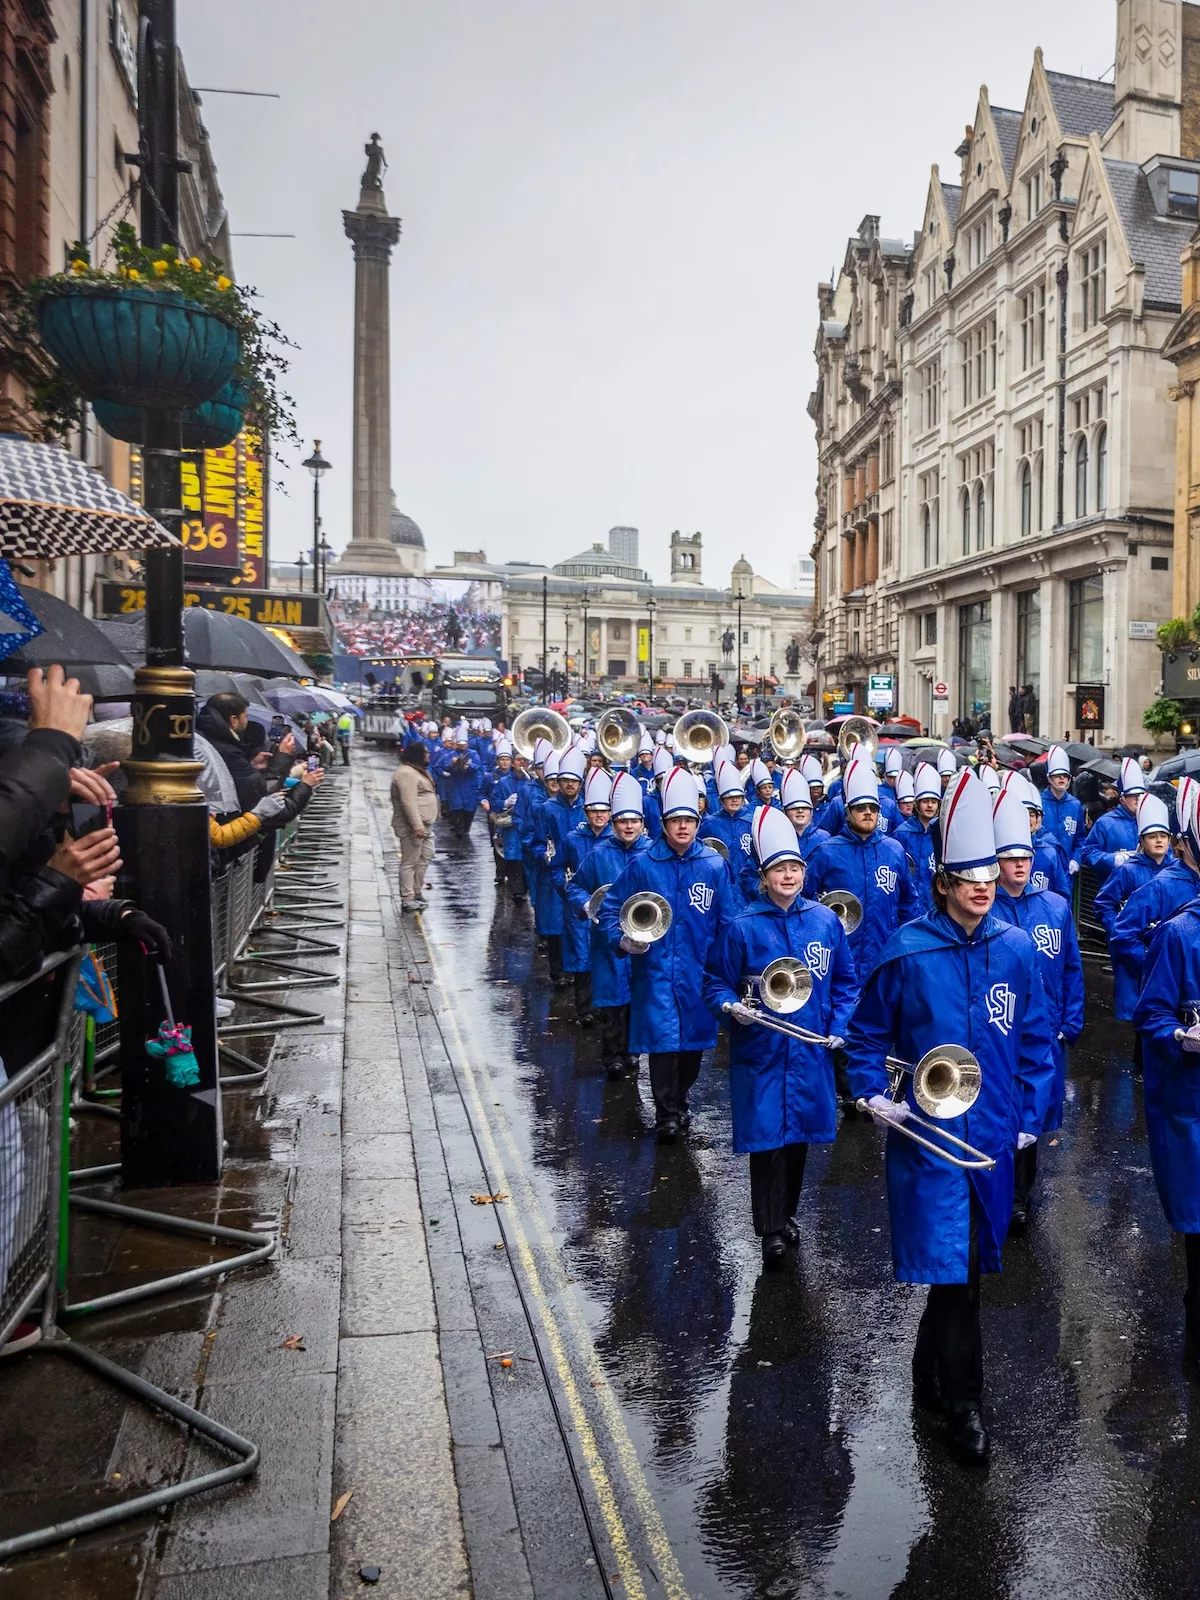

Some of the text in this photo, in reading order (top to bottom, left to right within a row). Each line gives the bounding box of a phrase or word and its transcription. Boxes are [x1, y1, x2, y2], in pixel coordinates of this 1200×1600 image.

[204, 442, 237, 519] CHANT
[181, 519, 228, 552] 36
[222, 597, 251, 620] 25
[256, 599, 303, 625] JAN
[874, 865, 897, 895] SU
[688, 882, 714, 914] SU
[1031, 923, 1061, 959] SU
[804, 941, 832, 981] SU
